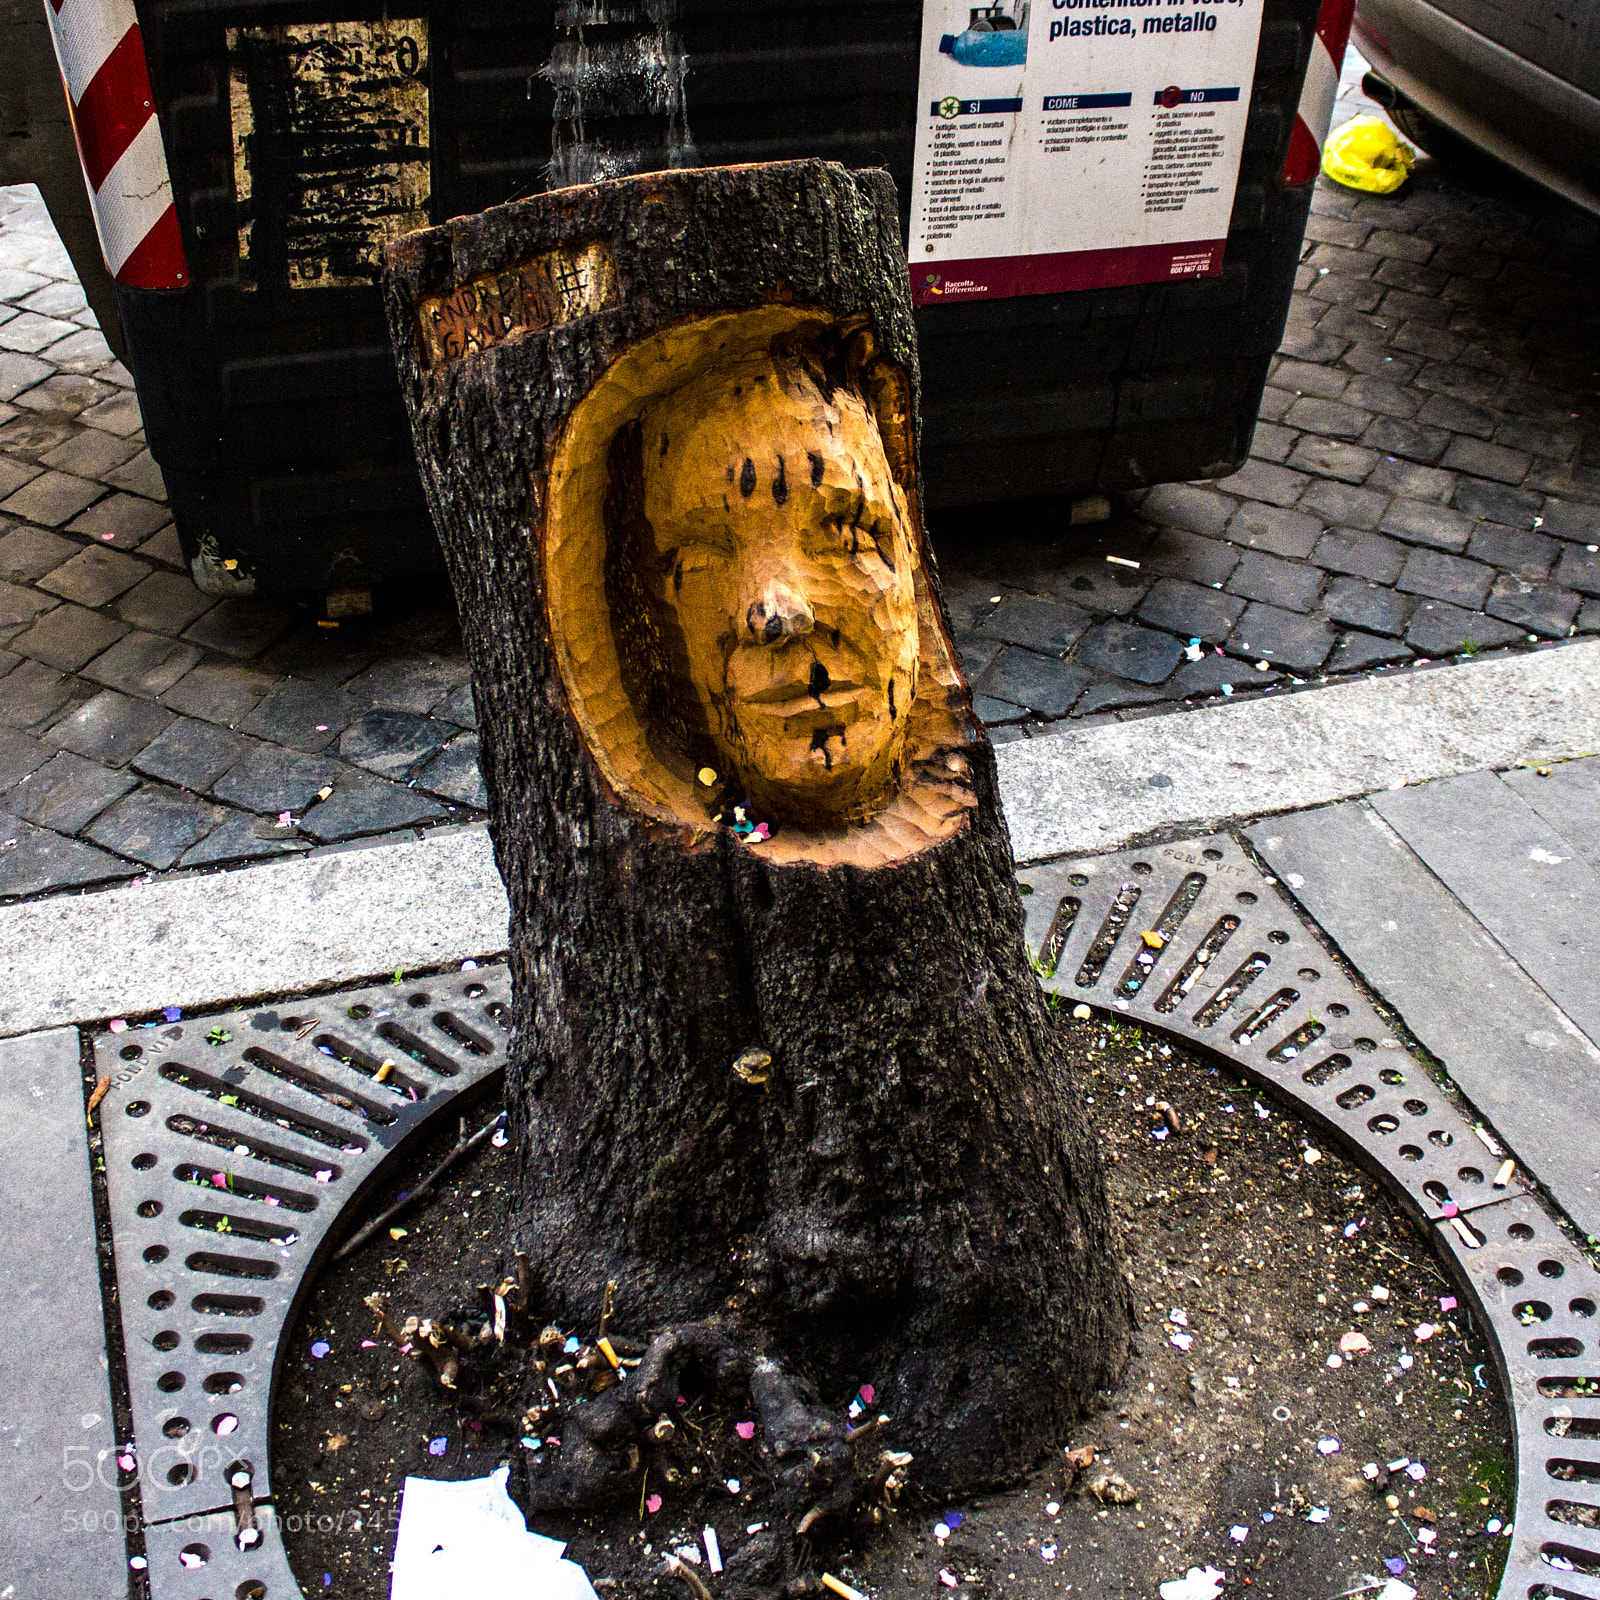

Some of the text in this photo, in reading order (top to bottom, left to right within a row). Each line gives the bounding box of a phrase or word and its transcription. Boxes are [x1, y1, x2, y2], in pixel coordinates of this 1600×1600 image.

[1050, 11, 1217, 42] plastica, metallo
[1048, 98, 1078, 109] COME
[1190, 92, 1204, 102] NO
[970, 100, 980, 113] SÌ
[945, 280, 987, 294] Raccolta Differenziata
